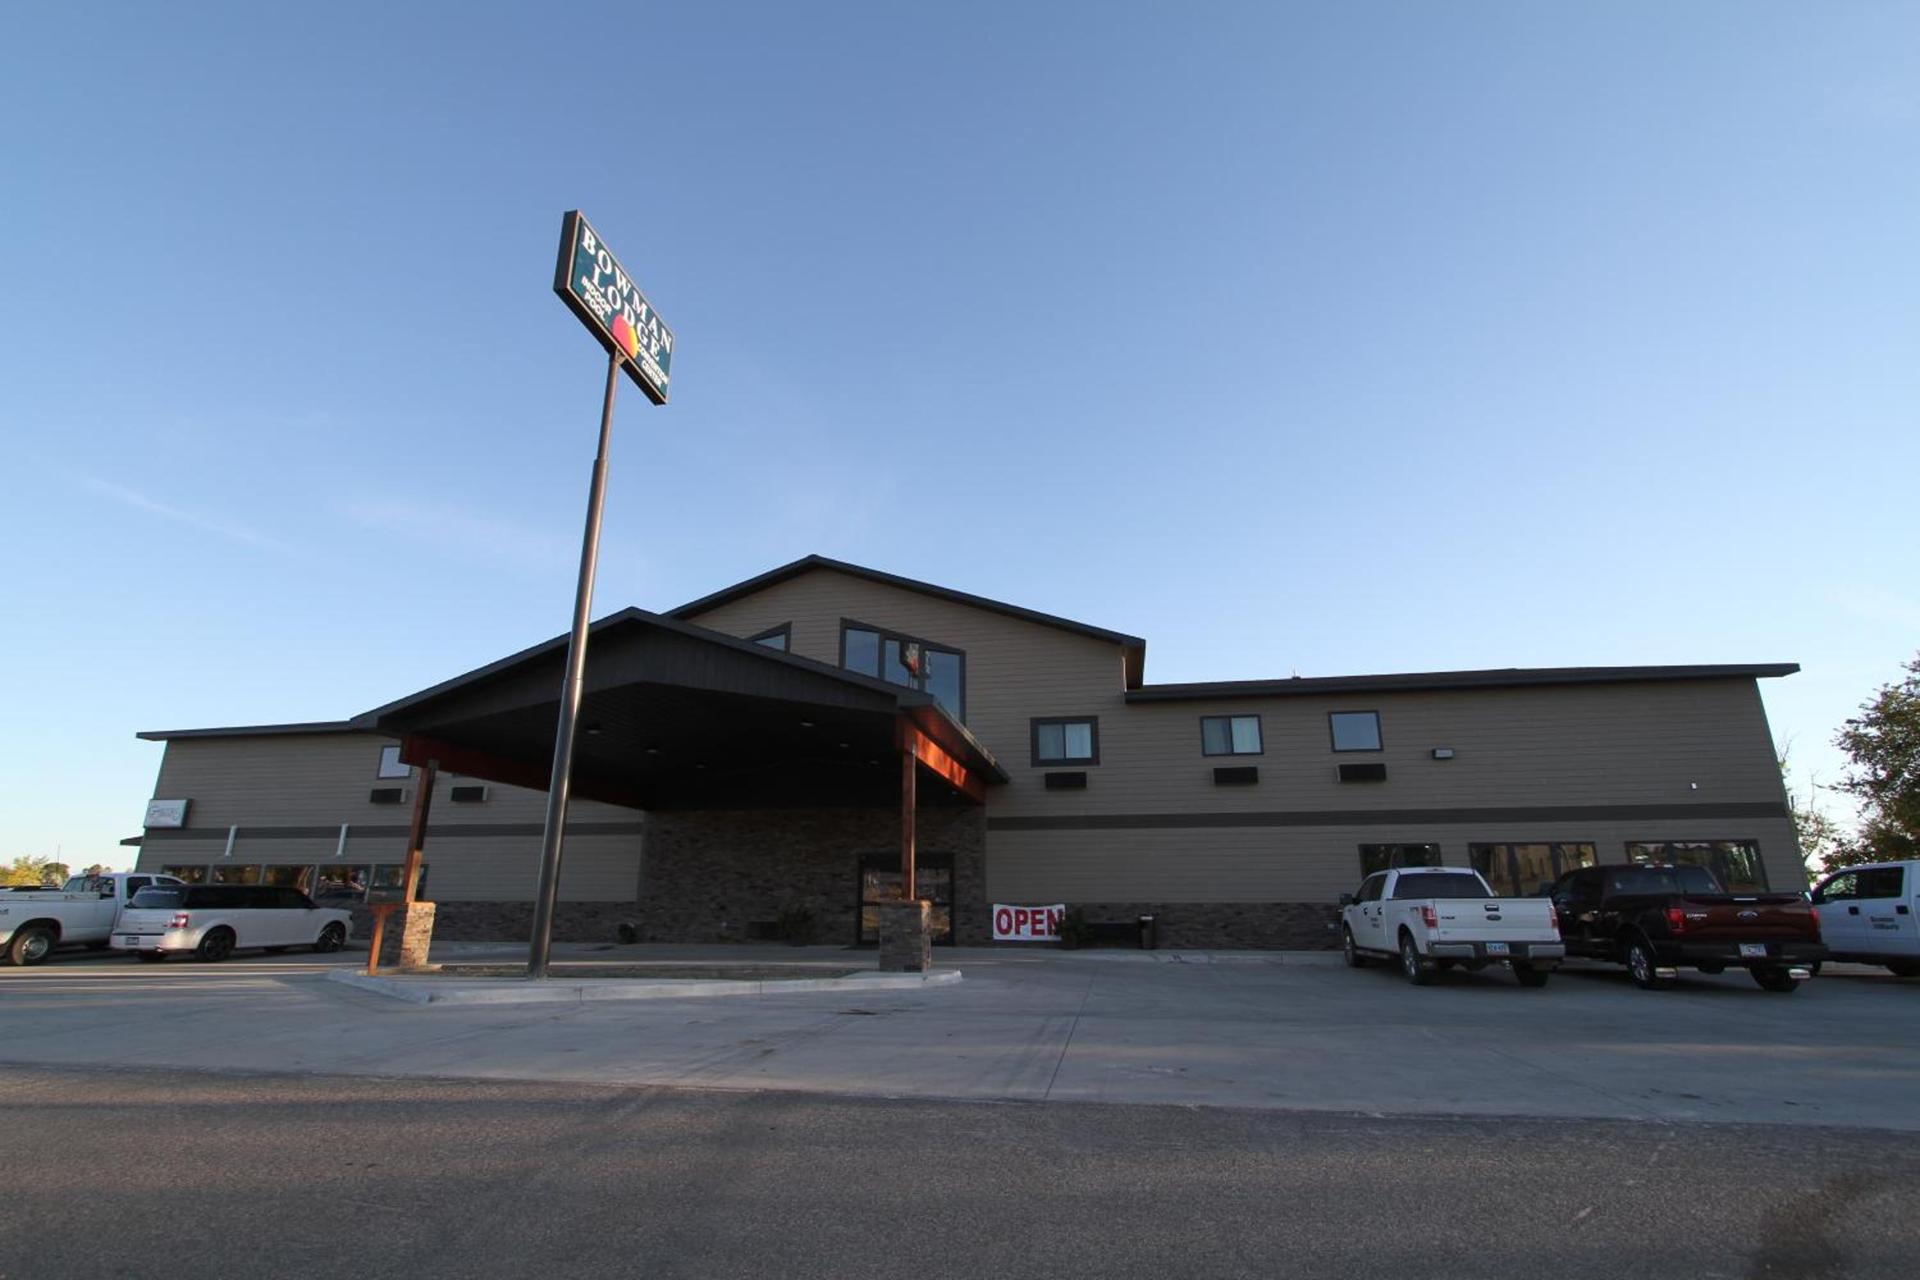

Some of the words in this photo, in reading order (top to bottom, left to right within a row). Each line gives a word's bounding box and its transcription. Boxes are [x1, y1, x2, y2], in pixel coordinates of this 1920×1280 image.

[581, 275, 612, 316] INDOOR
[582, 226, 672, 354] BOWMAN
[584, 291, 606, 321] POOL
[592, 263, 660, 361] LODGE
[995, 908, 1064, 936] OPEN
